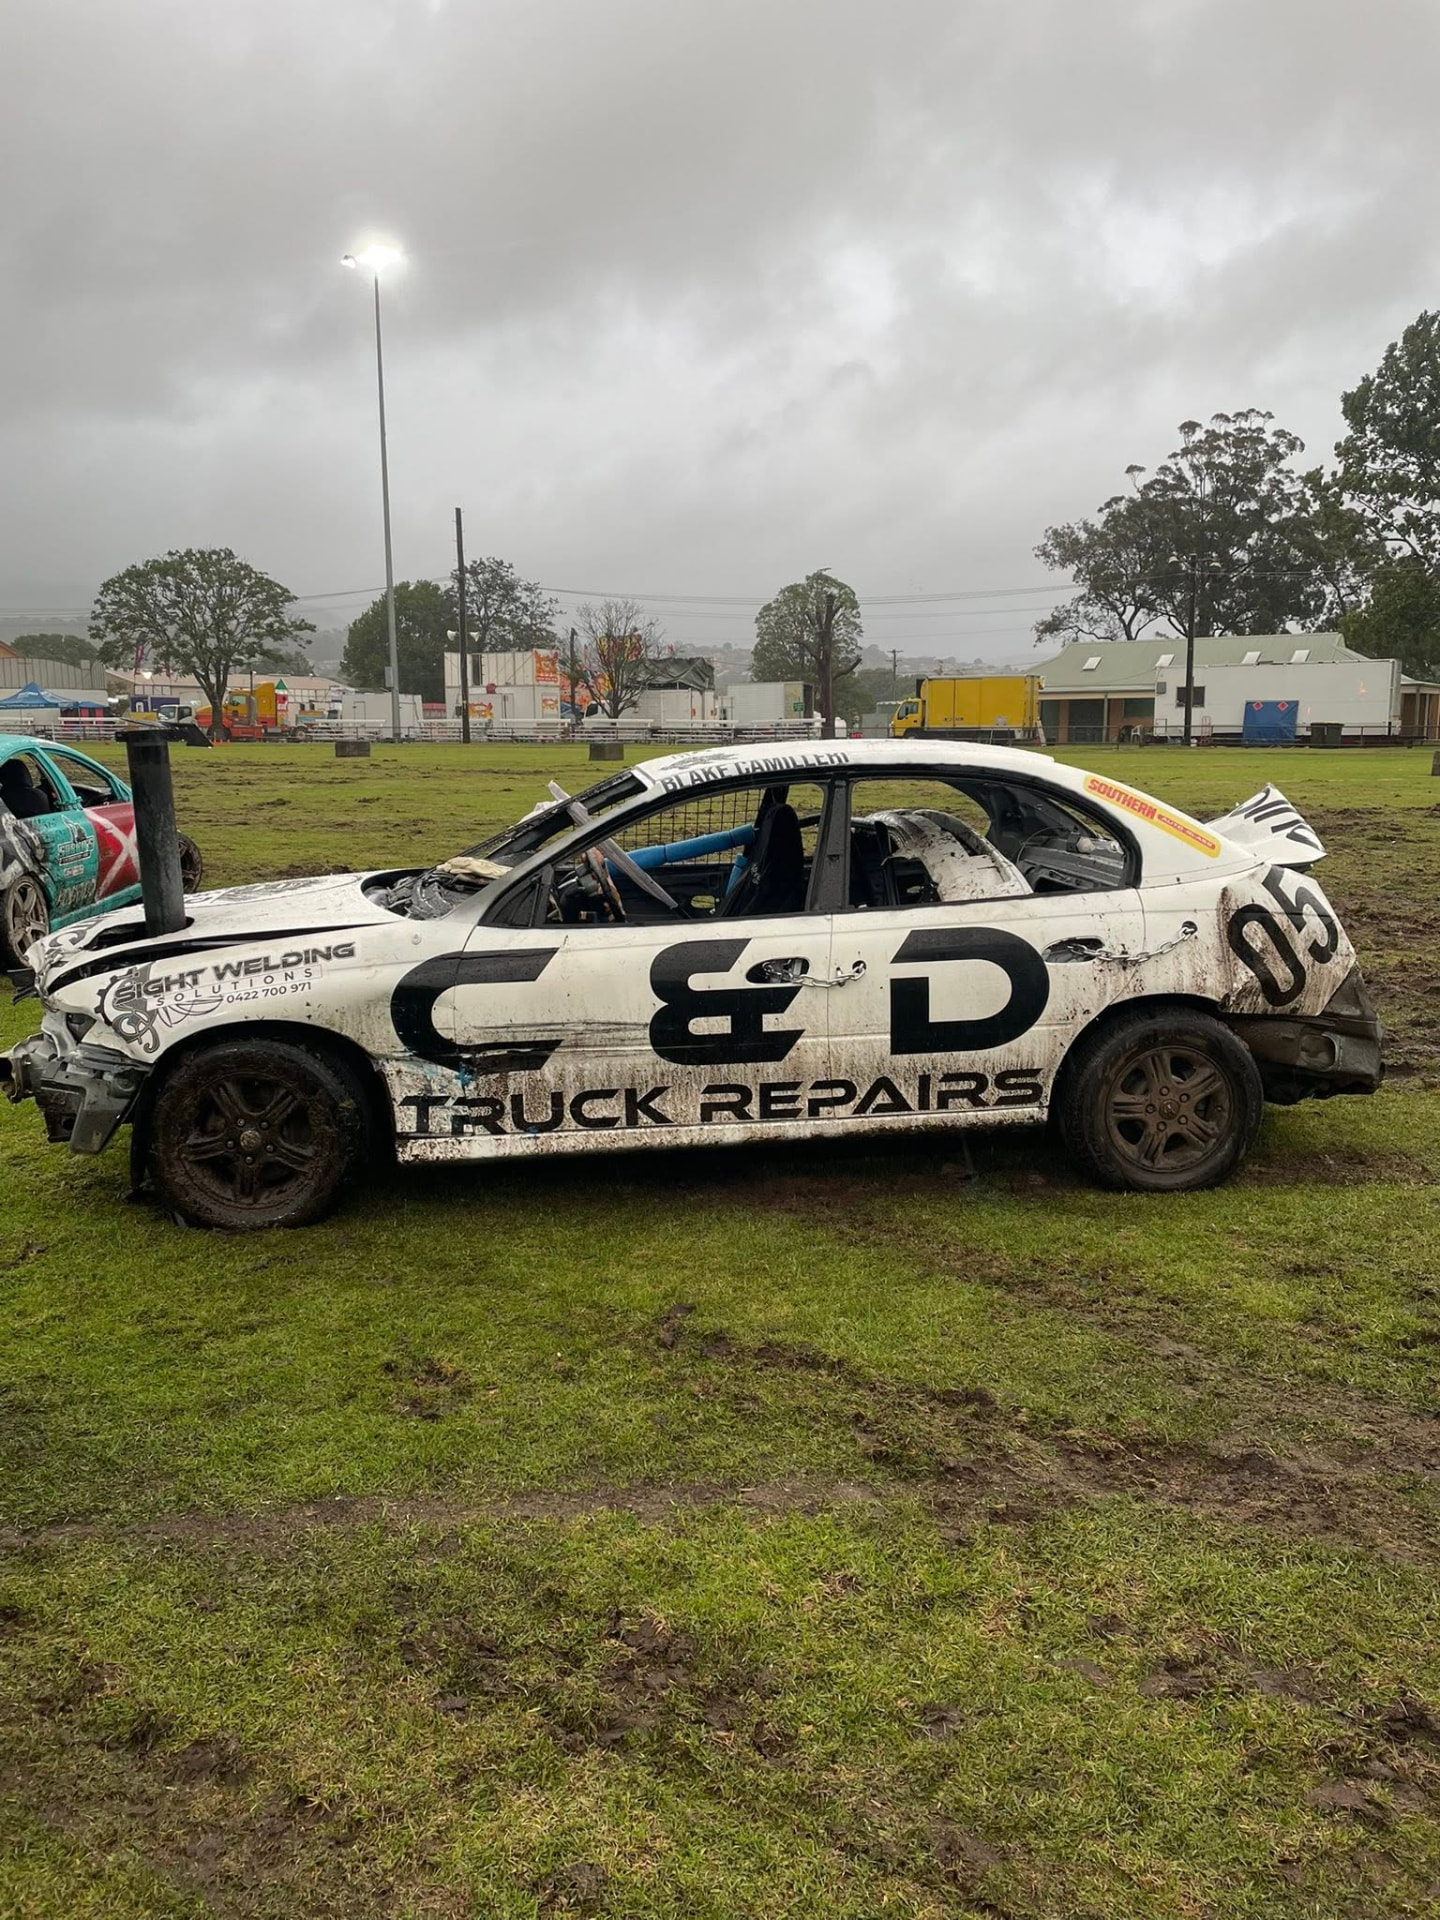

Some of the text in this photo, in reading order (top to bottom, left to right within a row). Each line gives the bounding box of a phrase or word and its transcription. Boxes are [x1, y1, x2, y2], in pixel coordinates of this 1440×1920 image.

[661, 751, 850, 794] BLAKE CAMILLERI
[1088, 779, 1158, 820] SOUTHERN
[1228, 866, 1339, 1007] 05
[114, 942, 356, 1002] SIGHT WELDING
[156, 968, 313, 1006] SOLUTIONS
[226, 982, 312, 1004] 0422 700 971
[391, 926, 1050, 1074] C & D
[399, 1068, 1044, 1136] TRUCK REPAIRS
